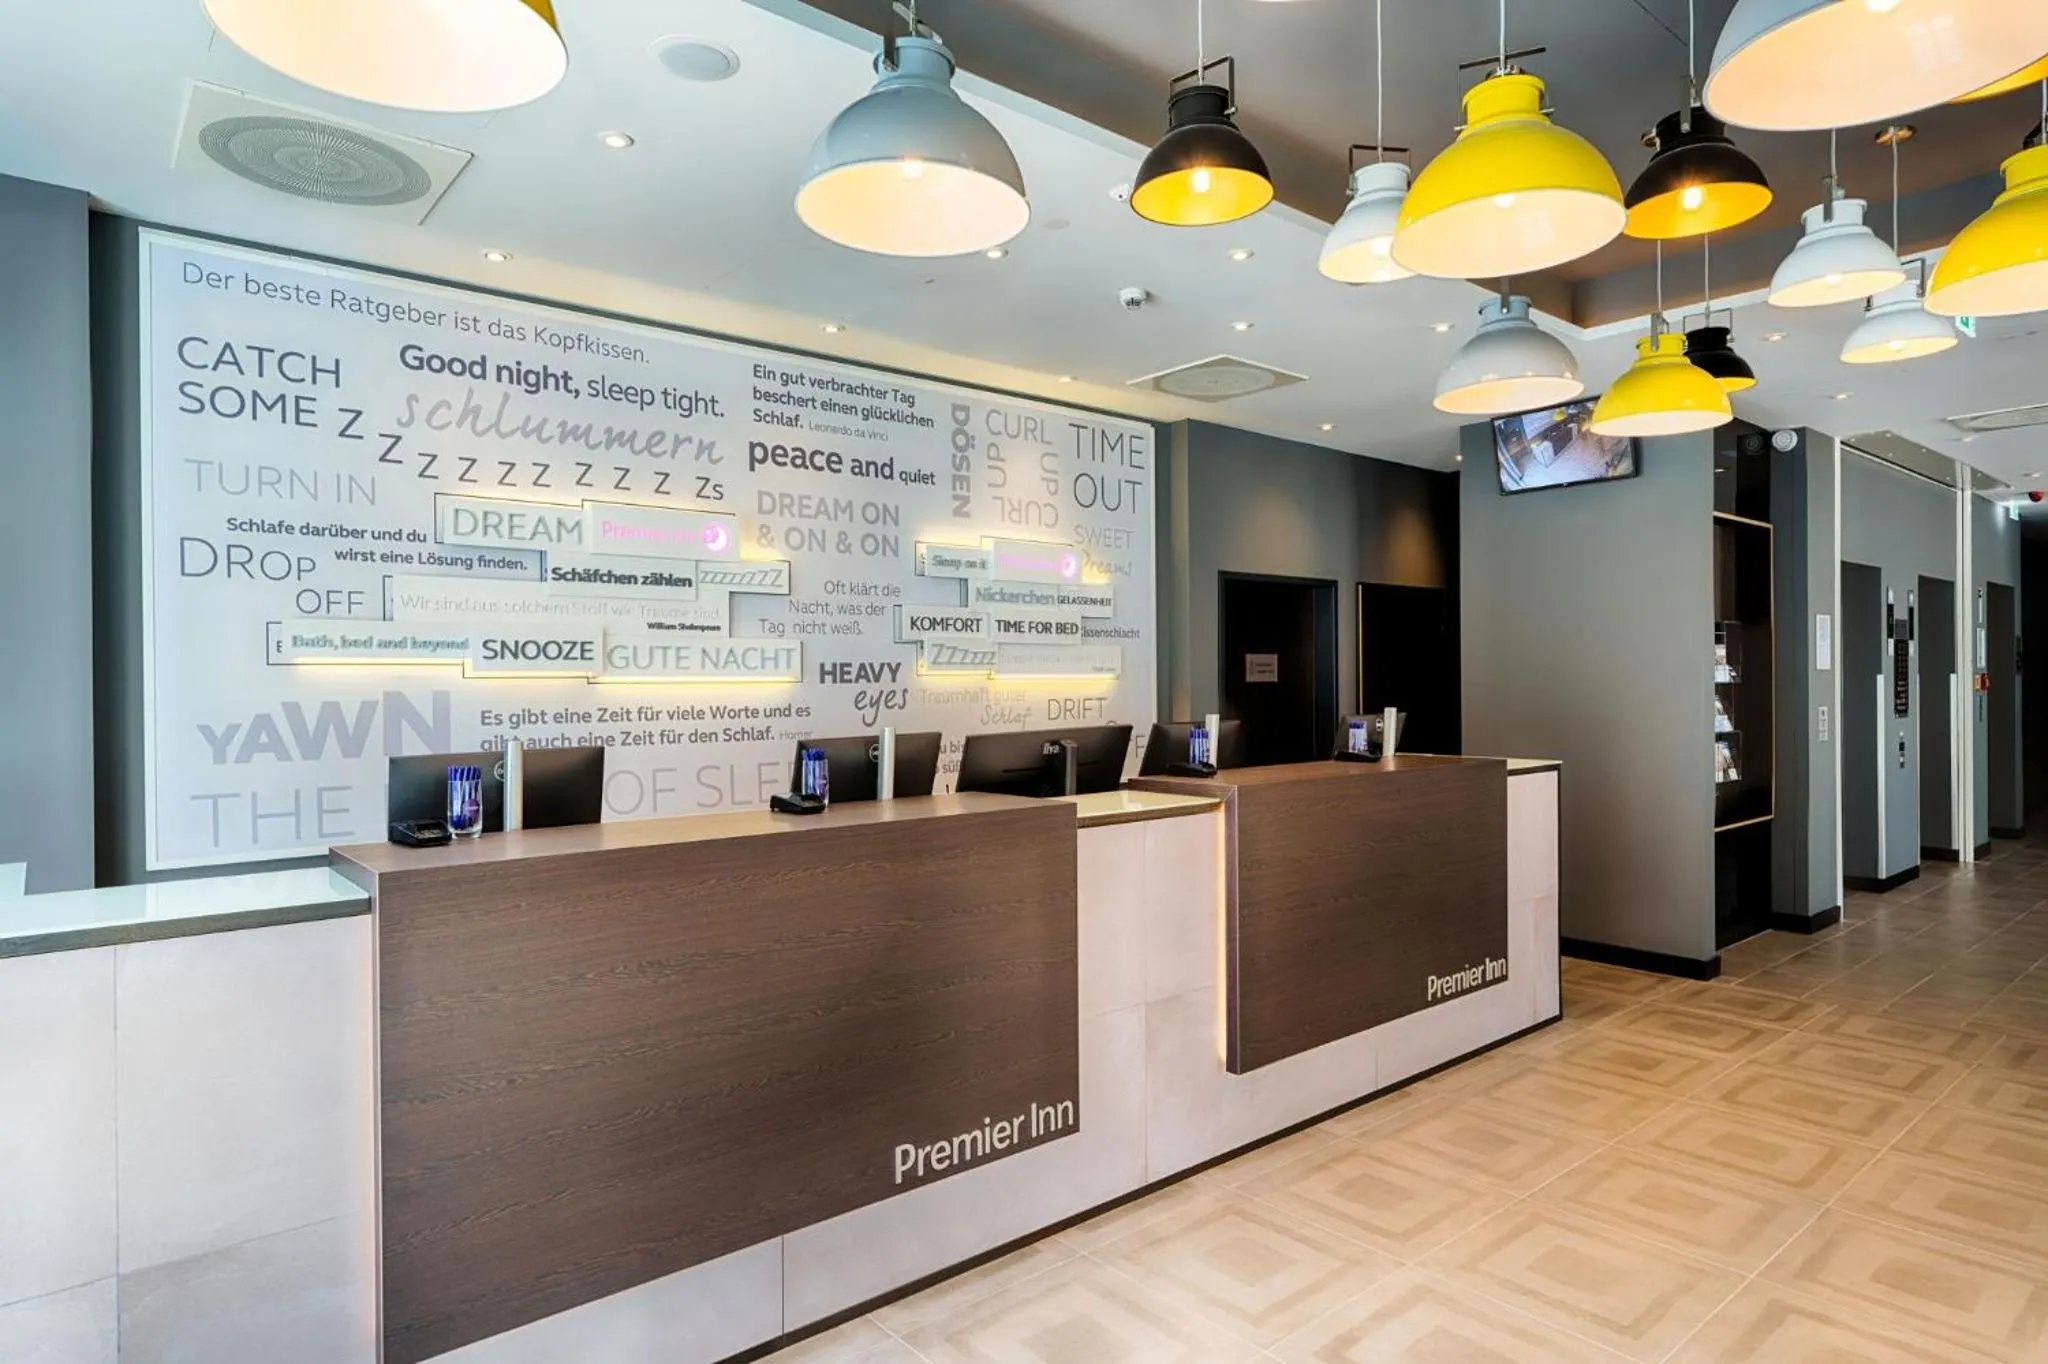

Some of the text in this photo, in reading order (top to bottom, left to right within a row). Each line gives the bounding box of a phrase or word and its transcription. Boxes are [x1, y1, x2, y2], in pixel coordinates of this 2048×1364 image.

[183, 261, 651, 365] Der beste Ratgeber ist das Kopfkissen.
[178, 336, 341, 388] CATCH
[399, 343, 725, 419] Good night, sleep tight.
[753, 364, 915, 408] Ein gut verbrachter Tag
[178, 380, 319, 429] SOME
[753, 387, 935, 428] beschert einen glücklichen
[753, 408, 804, 428] Schlaf.
[396, 386, 724, 465] schlummern
[985, 409, 1052, 445] CURL
[749, 440, 936, 486] peace and quiet
[951, 403, 976, 519] DÖSEN
[1069, 423, 1144, 469] TIME
[184, 458, 376, 506] TURN IN
[987, 443, 1007, 489] UP
[1040, 453, 1059, 496] UP
[757, 490, 899, 527] DREAM ON
[1074, 473, 1142, 514] OUT
[453, 508, 583, 544] DREAM
[992, 496, 1059, 528] CURL
[227, 517, 427, 544] Schlafe darüber und du
[757, 524, 899, 558] & ON & ON
[1073, 524, 1137, 549] SWEET
[180, 536, 317, 581] DROP
[335, 548, 528, 571] wirst eine Lösung finden.
[552, 566, 693, 588] Schäfchen zählen
[824, 580, 902, 598] Oft klärt die
[296, 588, 365, 615] OFF
[789, 600, 886, 616] Nacht, was der
[976, 587, 1055, 605] Nickerchen
[758, 618, 864, 637] Tag nicht weiß.
[910, 616, 983, 633] KOMFORT
[995, 618, 1079, 636] TIME FOR BED
[1081, 626, 1140, 639] issenschlacht
[482, 638, 595, 661] SNOOZE
[608, 644, 797, 670] GUTE NACHT
[819, 662, 901, 684] HEAVY
[480, 703, 811, 729] Es gibt eine Zeit für viele Worte und es
[854, 688, 908, 727] eyes
[1048, 697, 1108, 721] DRIFT
[196, 690, 451, 765] YAWN
[577, 732, 616, 747] eine
[620, 730, 655, 747] Zeit
[659, 729, 683, 745] für
[689, 727, 719, 743] den
[723, 726, 775, 743] Schlaf.
[605, 760, 794, 815] OF SLE
[190, 785, 354, 847] THE
[1428, 957, 1507, 1001] Premier Inn
[895, 1099, 1074, 1185] Premier Inn
